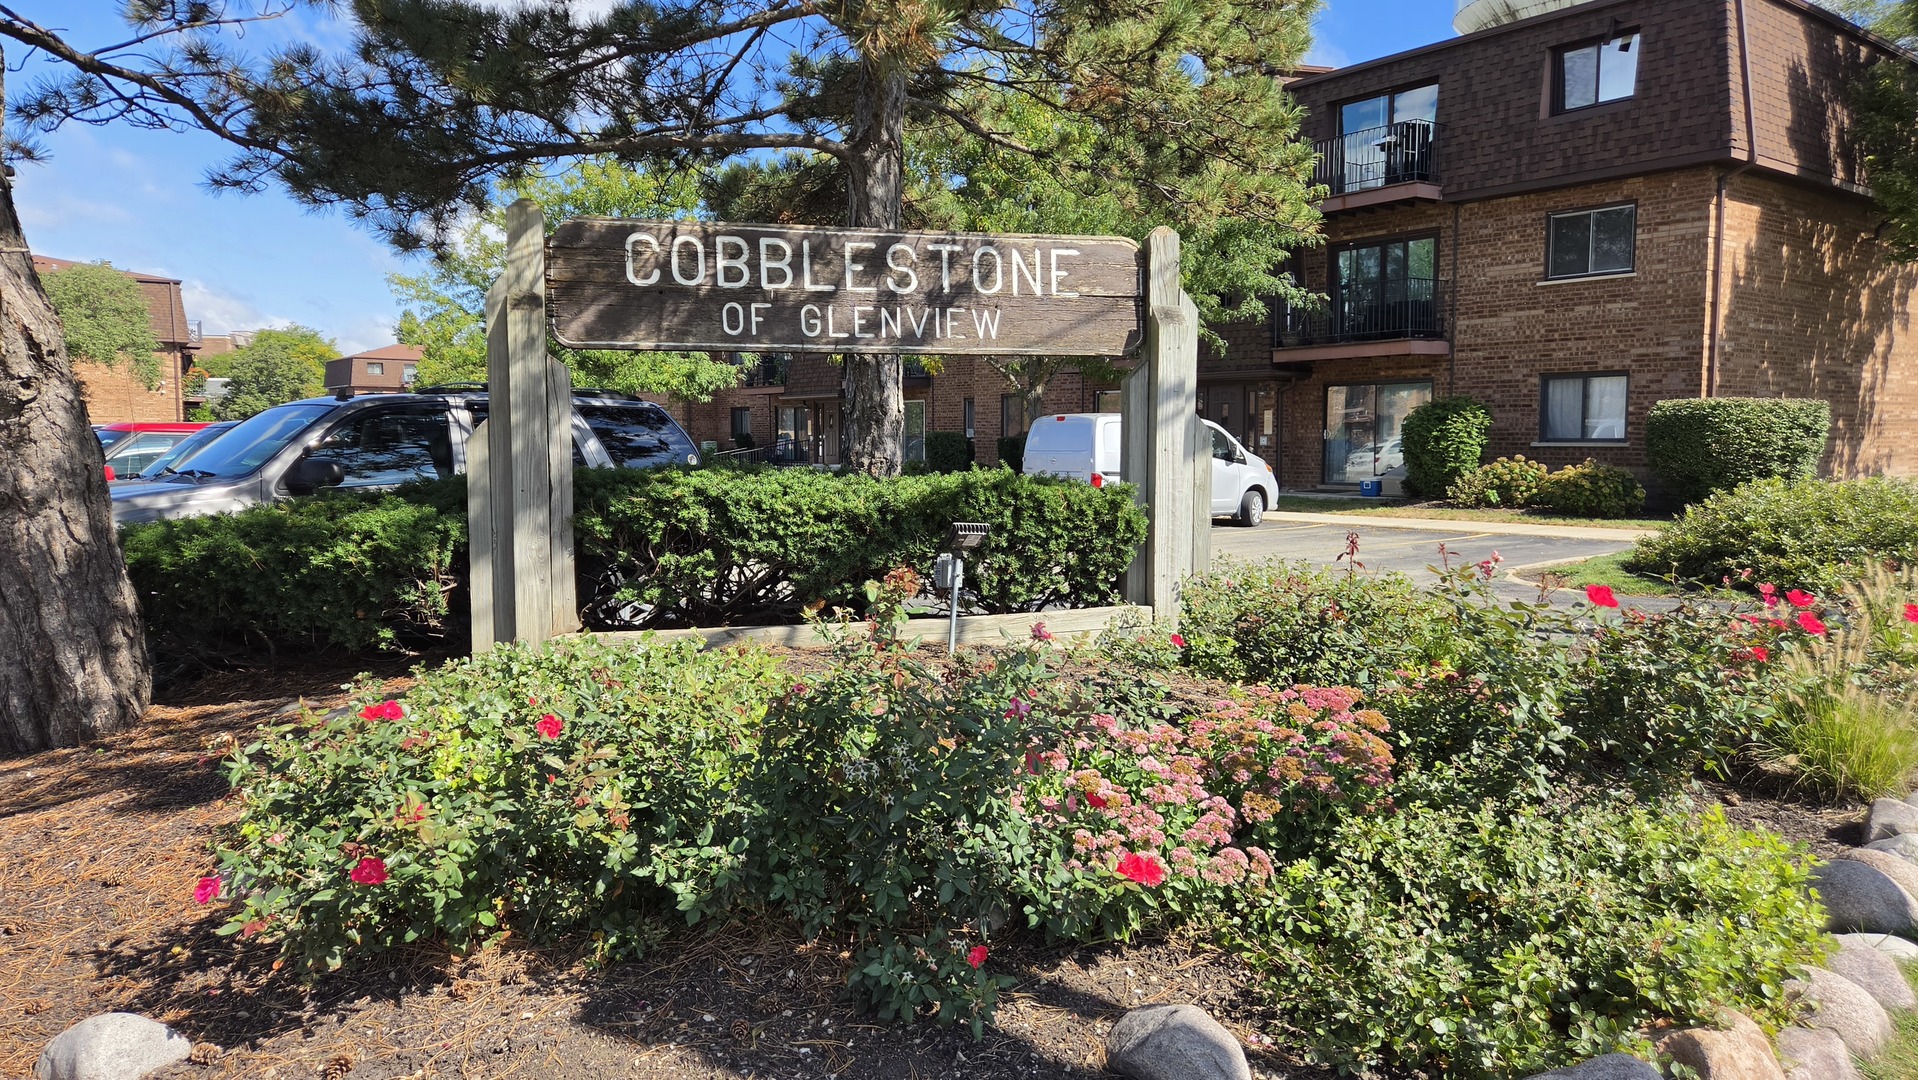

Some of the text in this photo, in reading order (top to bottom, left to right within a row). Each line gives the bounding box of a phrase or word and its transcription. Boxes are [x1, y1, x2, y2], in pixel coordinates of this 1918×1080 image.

[625, 231, 1081, 297] COBBLESTONE
[722, 302, 1000, 339] OF GLENVIEW
